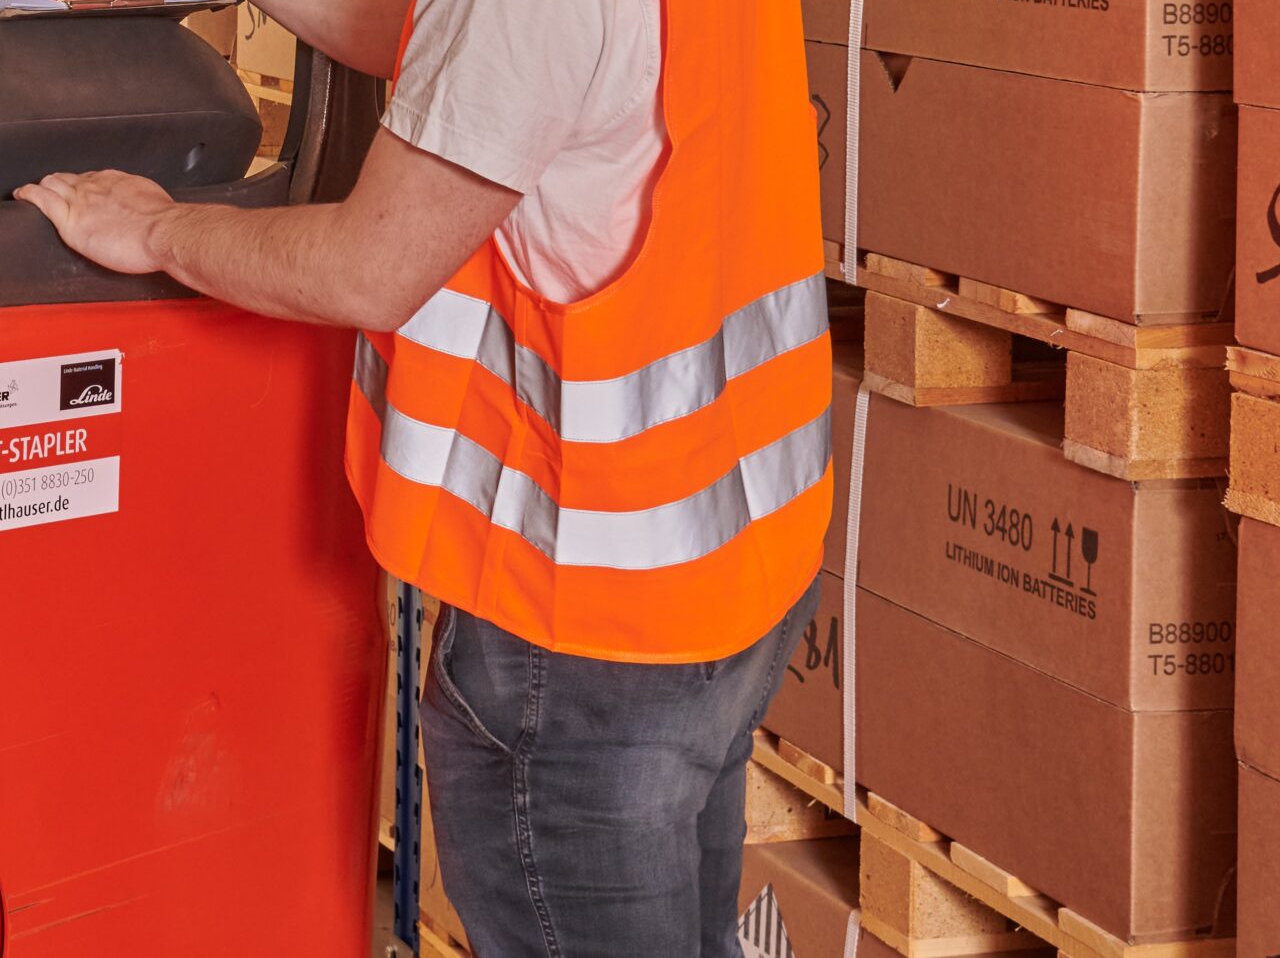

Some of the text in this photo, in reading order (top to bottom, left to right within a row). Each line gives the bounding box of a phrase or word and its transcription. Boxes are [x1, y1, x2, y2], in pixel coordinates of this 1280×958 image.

[1163, 3, 1232, 24] B8890
[70, 384, 112, 405] Linde
[1, 477, 36, 499] (0)351
[40, 467, 95, 490] 8830-250
[947, 484, 1033, 552] UN 3480
[946, 541, 1096, 620] LITHIUM ION BATTERIES
